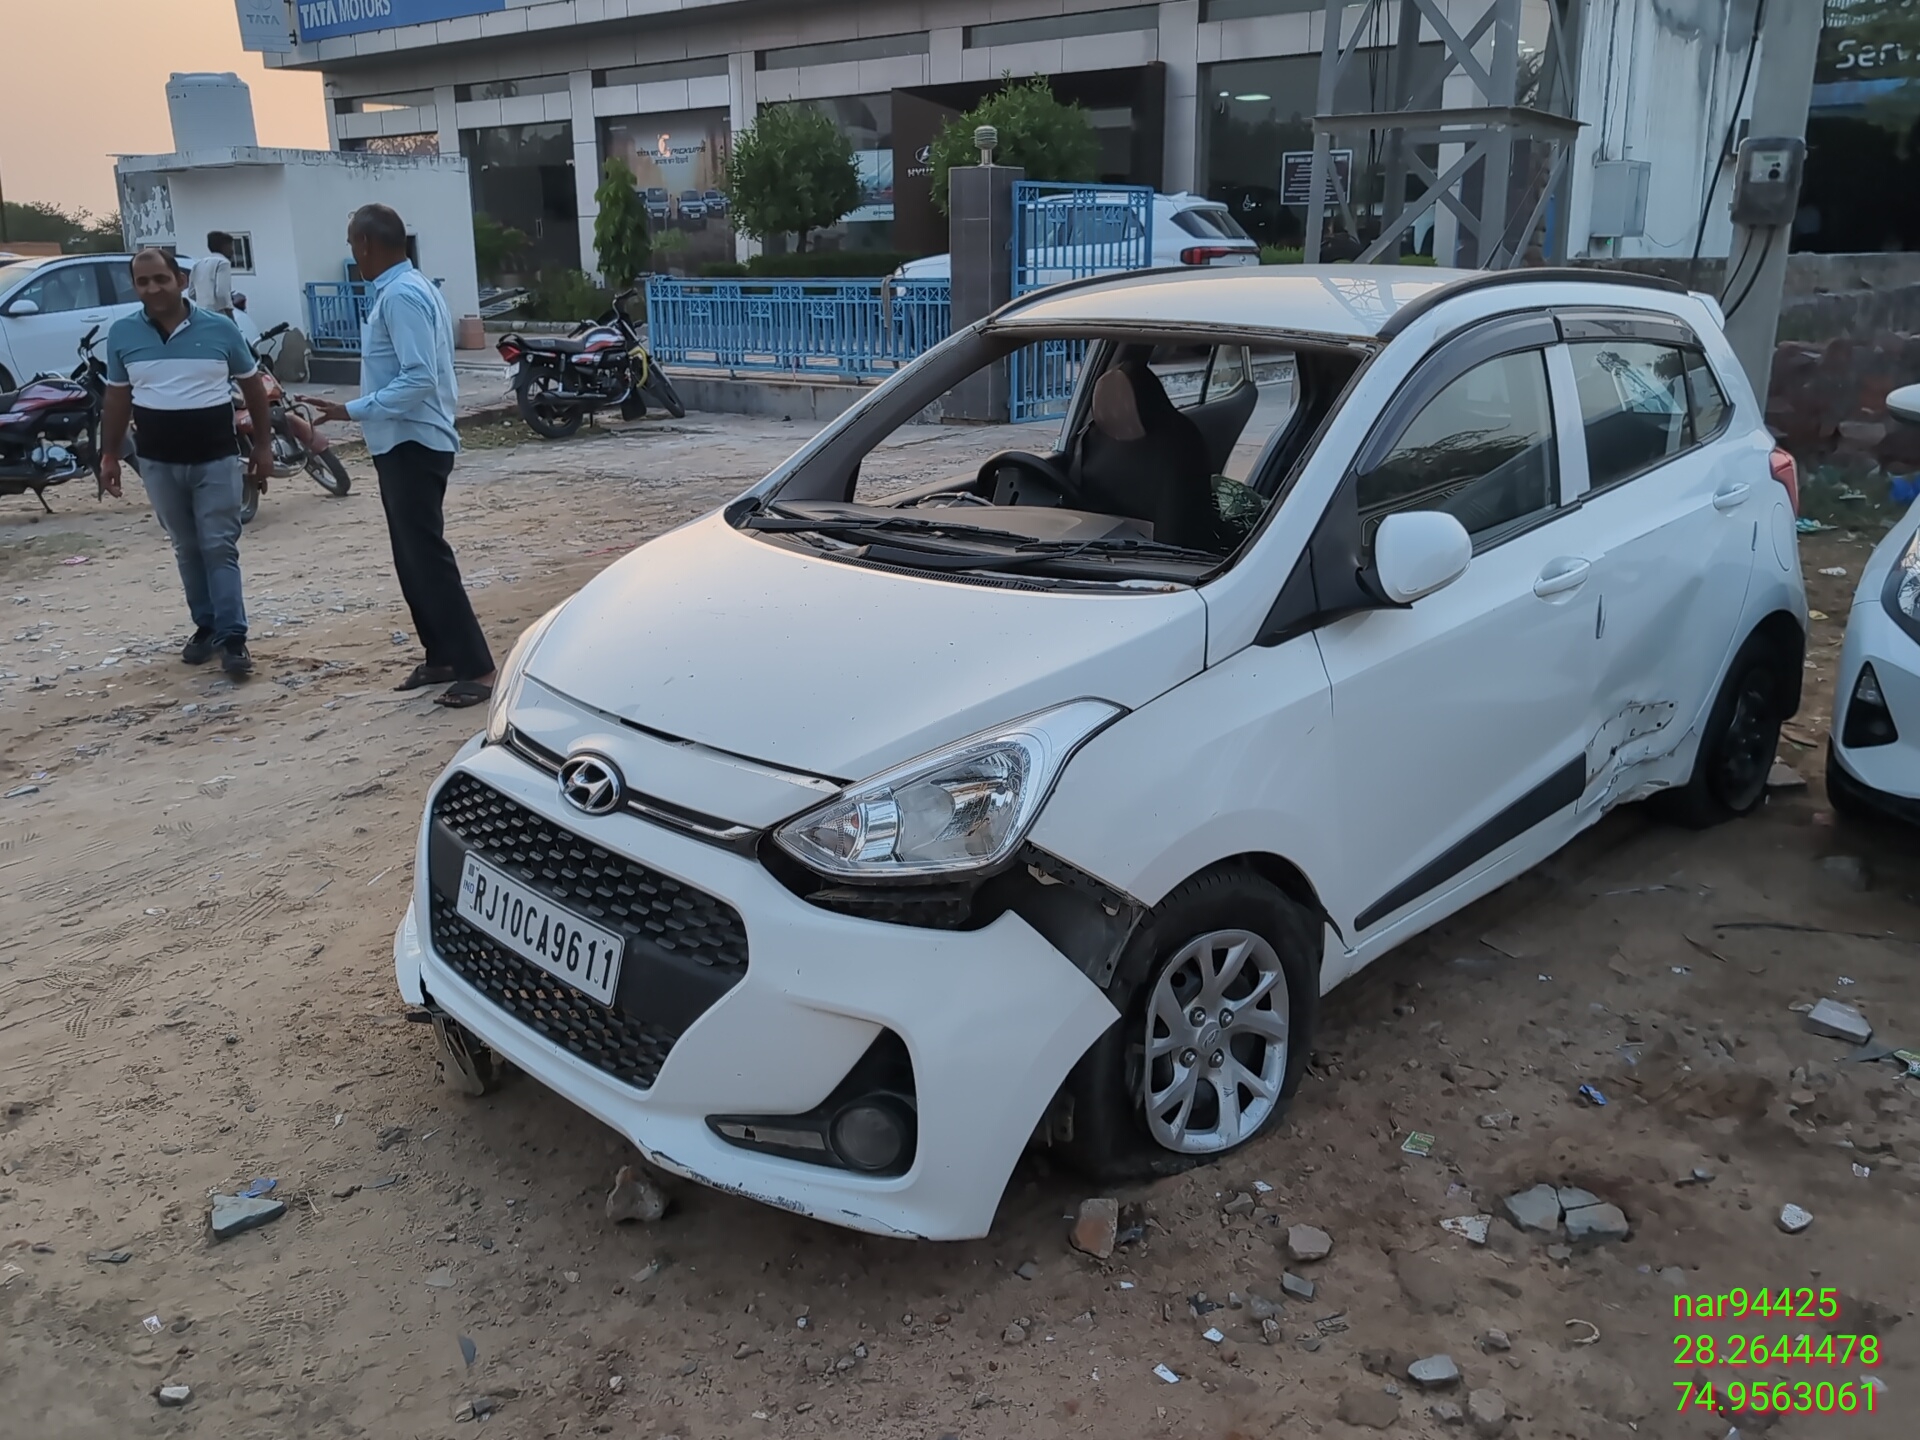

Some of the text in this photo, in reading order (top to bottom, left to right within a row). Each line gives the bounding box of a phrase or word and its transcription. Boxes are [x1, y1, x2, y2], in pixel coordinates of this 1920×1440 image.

[246, 14, 280, 25] TATA
[299, 0, 391, 29] TATA MOTORS
[473, 873, 614, 991] RJ10CA9611
